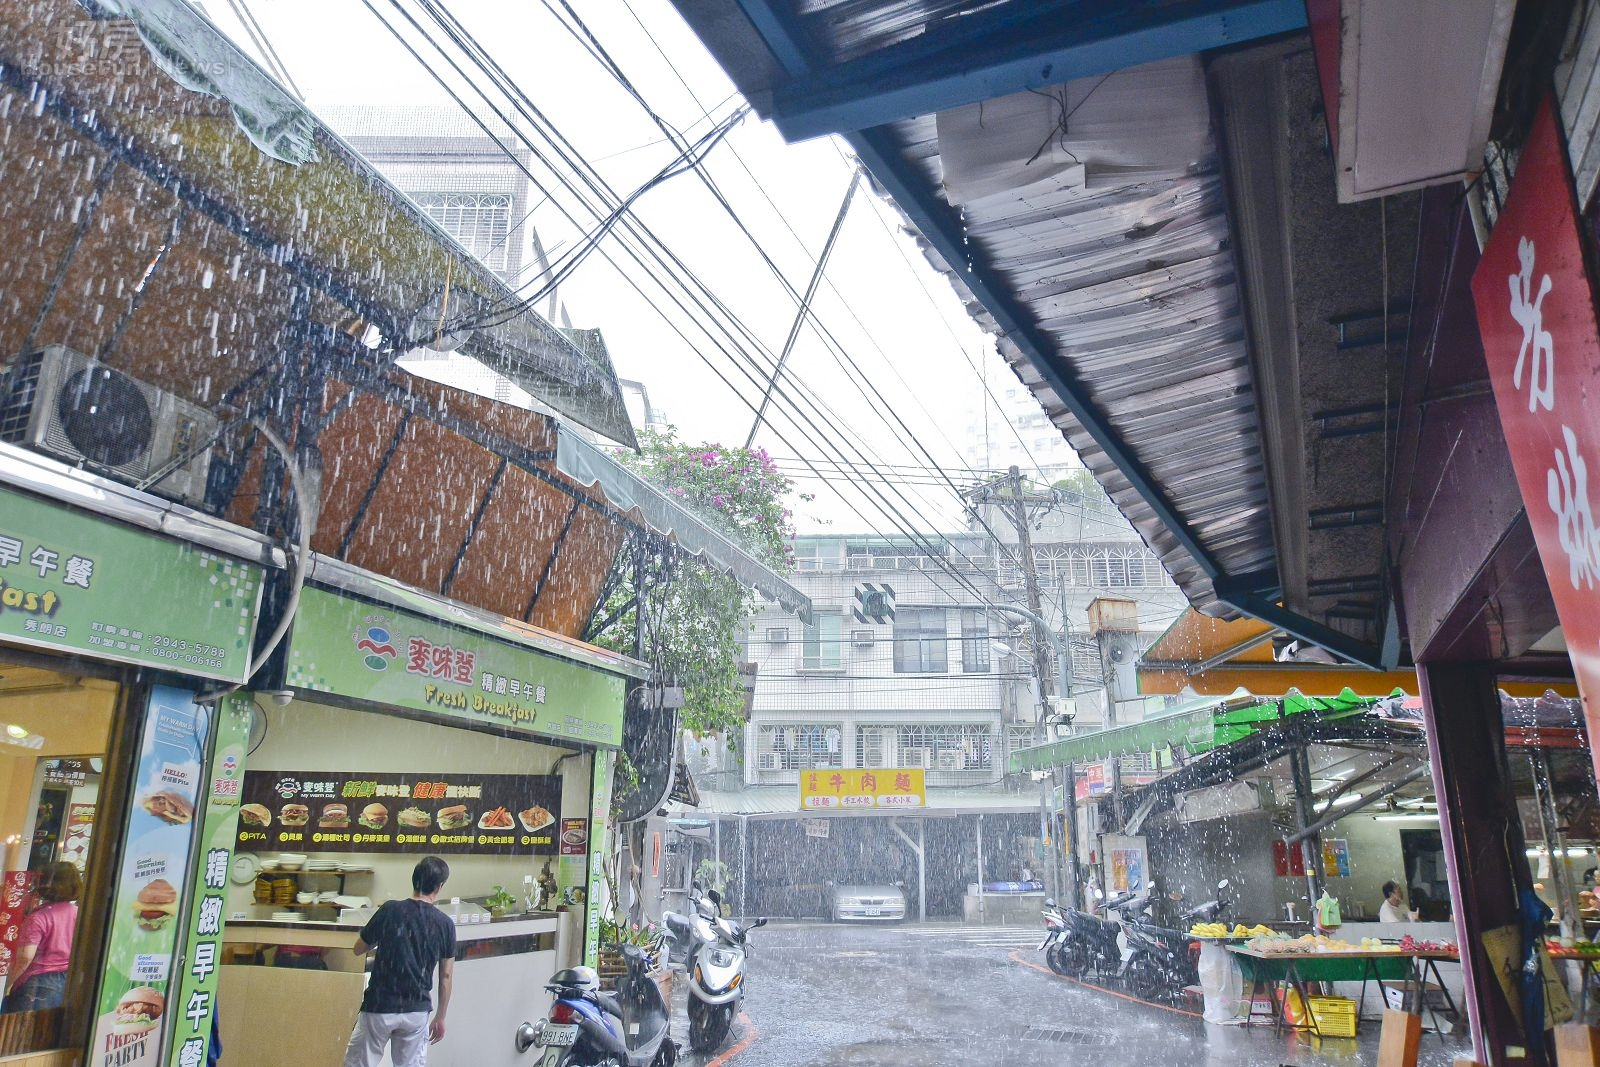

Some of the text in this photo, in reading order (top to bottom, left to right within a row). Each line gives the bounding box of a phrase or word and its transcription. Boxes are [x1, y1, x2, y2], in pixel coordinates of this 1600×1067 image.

[0, 576, 57, 615] ast
[25, 619, 67, 638] 秀朗店
[407, 637, 475, 686] 麥味登
[424, 684, 467, 709] Fresh
[481, 672, 546, 704] 精緻早午餐
[829, 772, 912, 793] 牛肉麵
[180, 848, 228, 1067] 精緻早午餐
